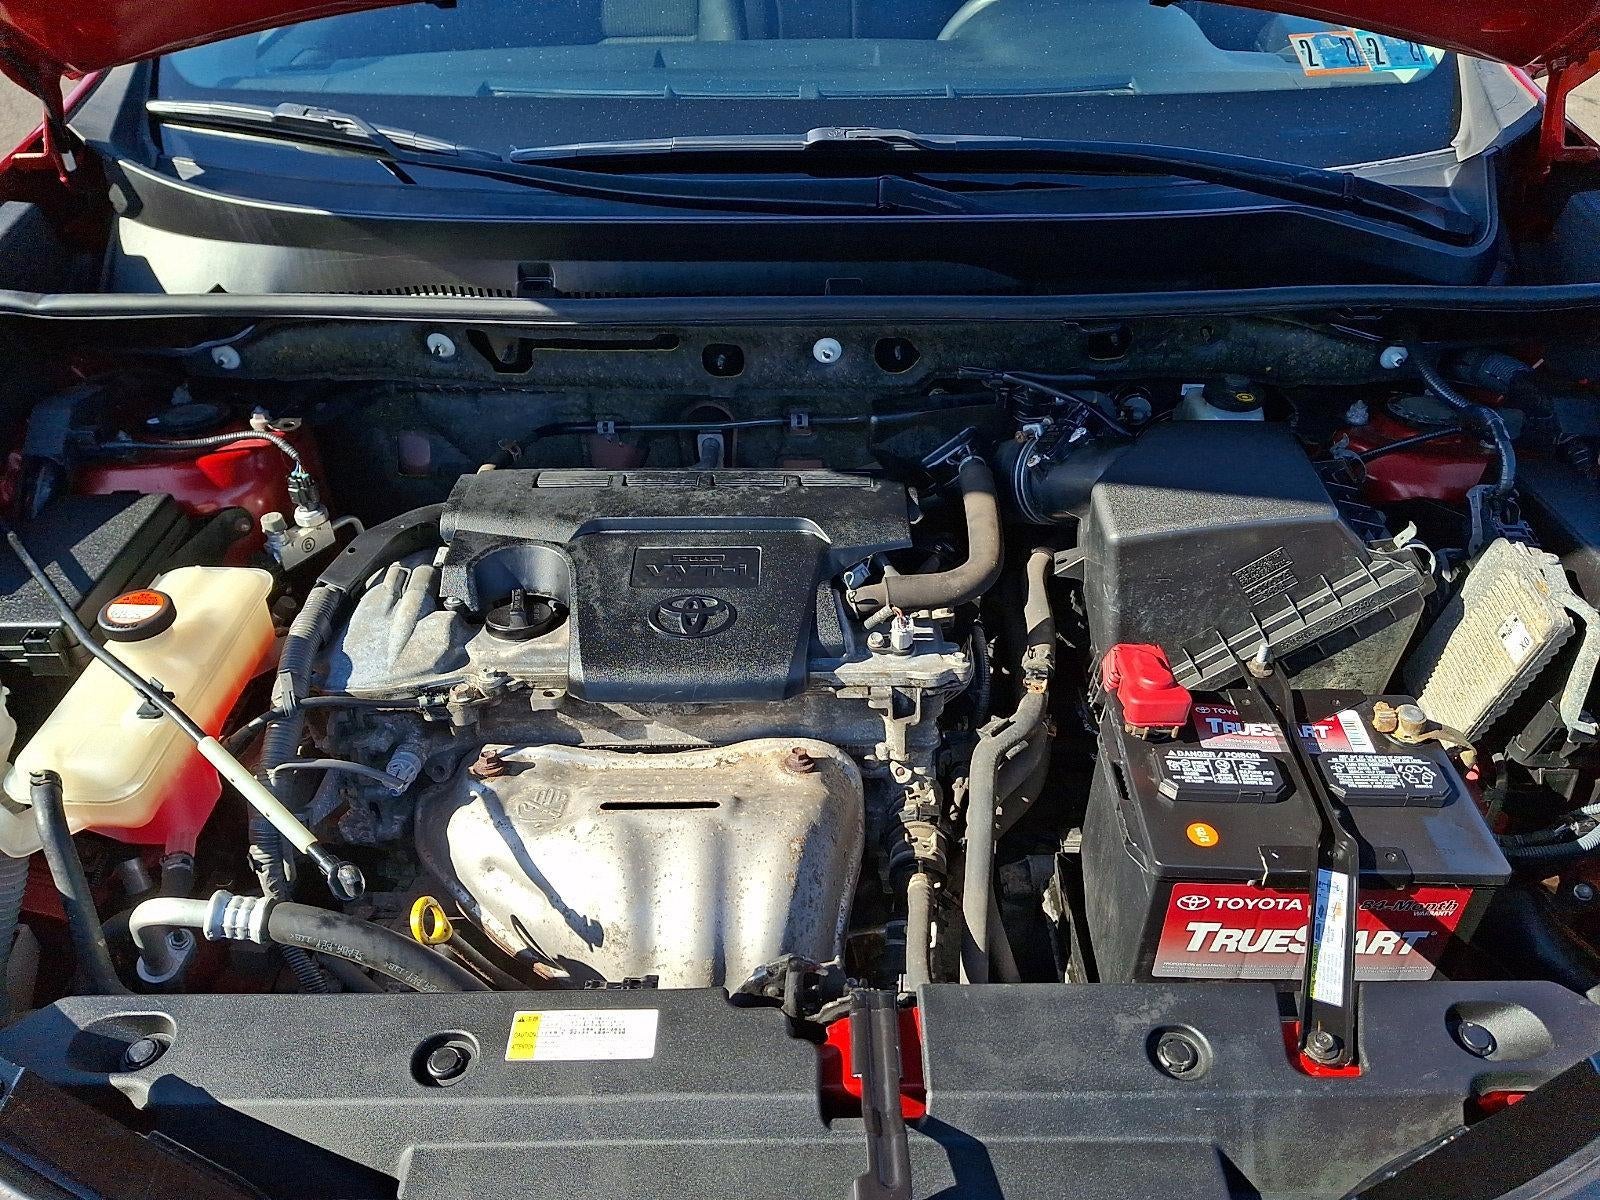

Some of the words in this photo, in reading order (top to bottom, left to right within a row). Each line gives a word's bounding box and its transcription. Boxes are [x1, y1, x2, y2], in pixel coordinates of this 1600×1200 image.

[1299, 39, 1319, 66] 2
[1366, 37, 1386, 65] 2
[1212, 707, 1238, 716] TOYO
[1176, 750, 1216, 758] DANGER
[1224, 751, 1260, 759] POISON
[1215, 897, 1303, 911] TOYOTA
